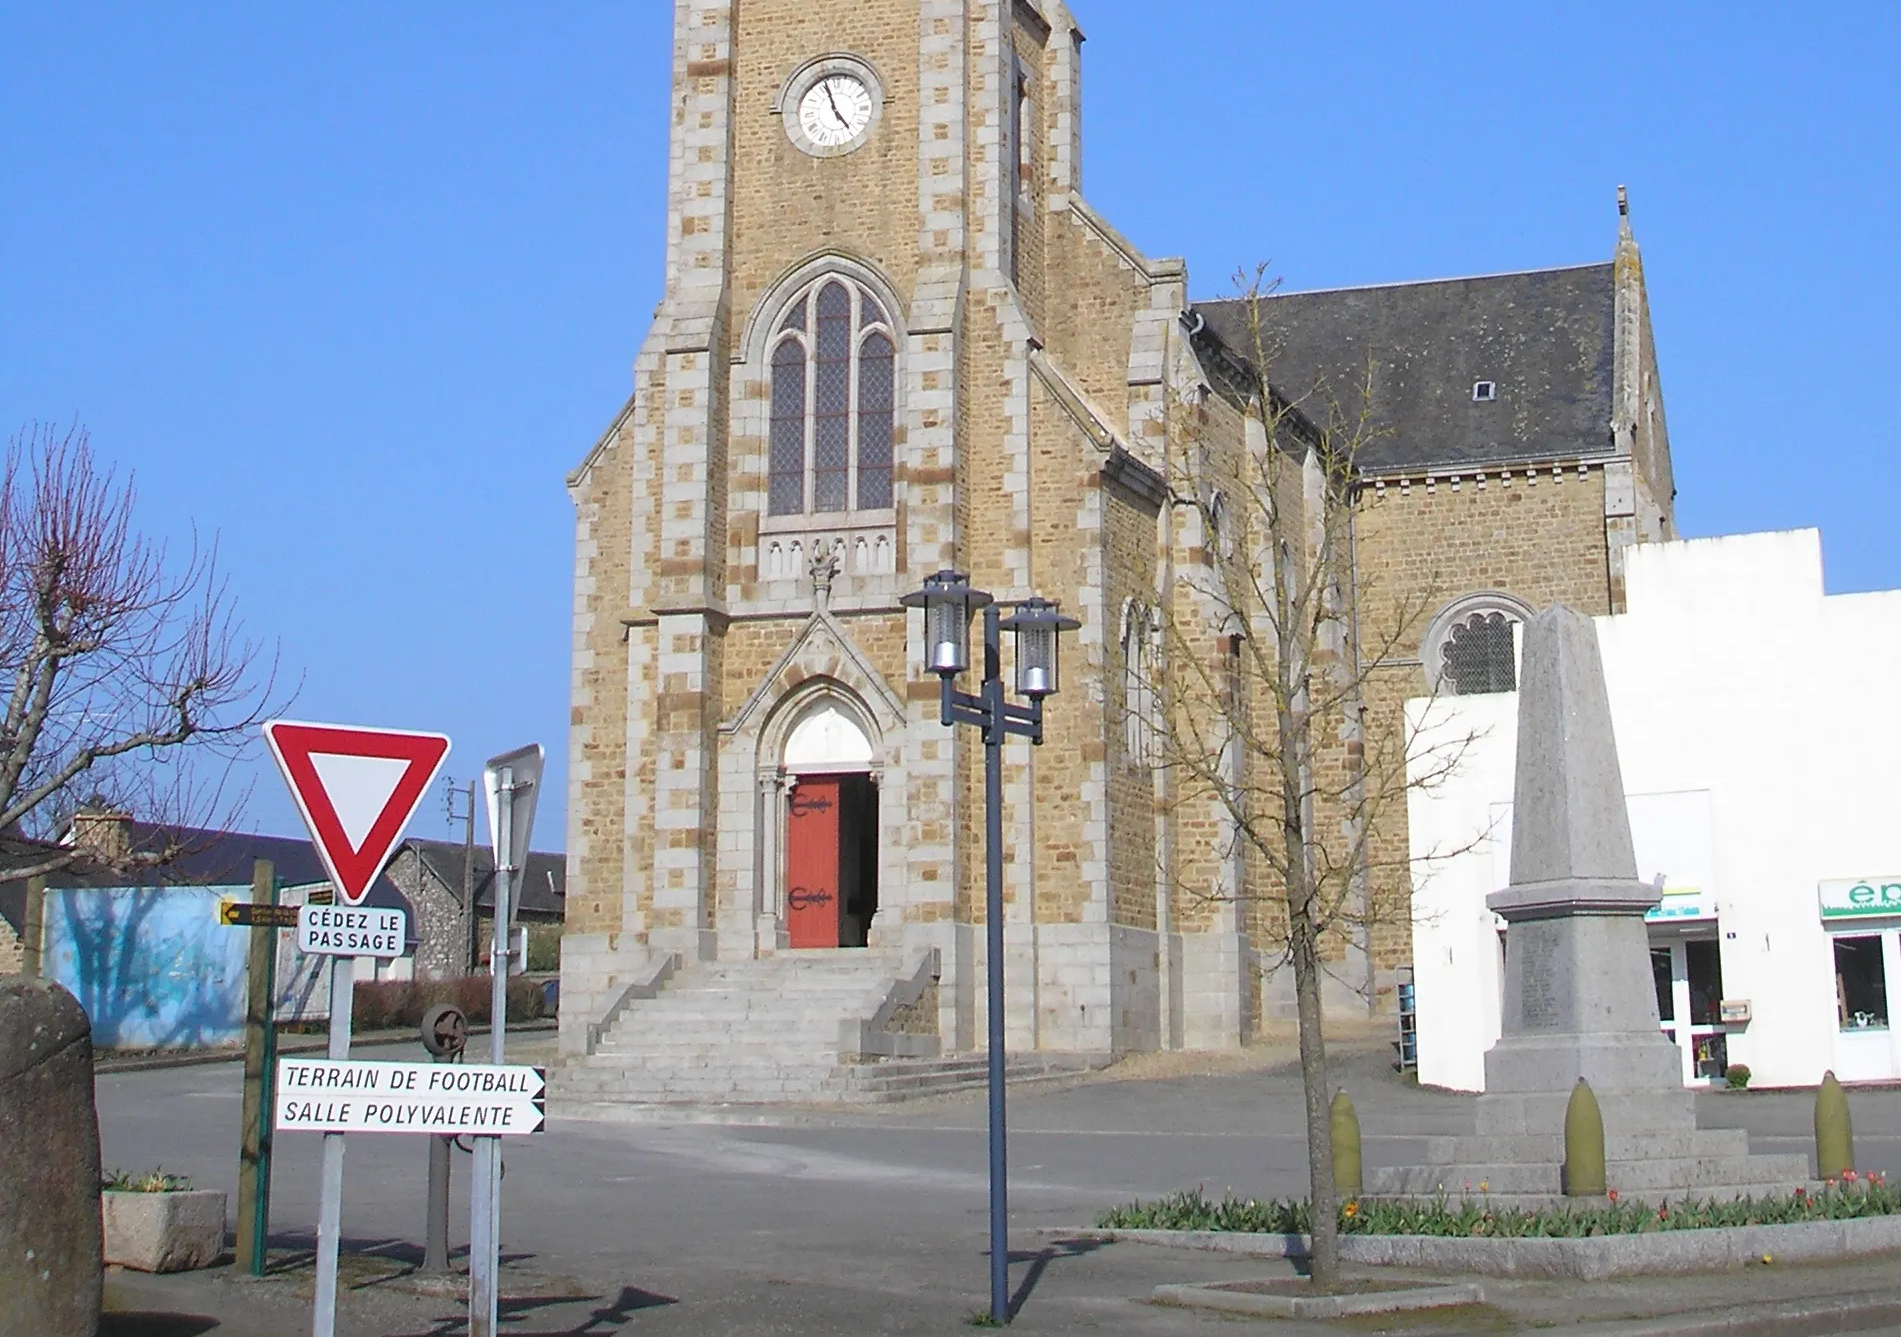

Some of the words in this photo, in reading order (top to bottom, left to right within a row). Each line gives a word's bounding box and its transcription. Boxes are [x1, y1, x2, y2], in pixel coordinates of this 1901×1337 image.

[308, 908, 368, 929] CÉDEZ
[380, 915, 399, 931] LE
[309, 930, 396, 951] PASSAGE
[287, 1066, 379, 1089] TERRAIN
[390, 1070, 418, 1090] DE
[428, 1071, 528, 1092] FOOTBALL
[284, 1101, 351, 1122] SALLE
[364, 1104, 513, 1126] POLYVALENTE
